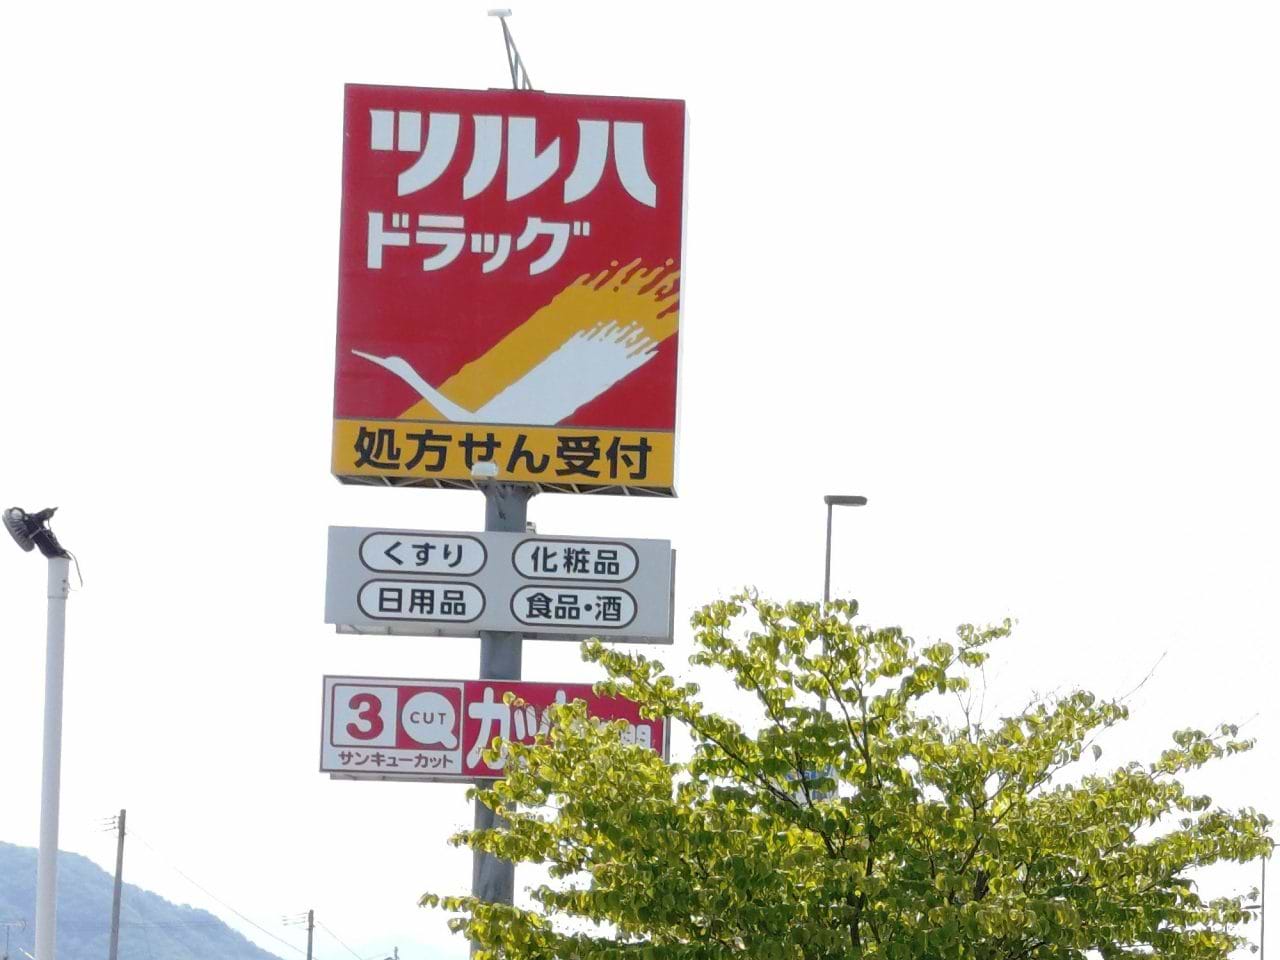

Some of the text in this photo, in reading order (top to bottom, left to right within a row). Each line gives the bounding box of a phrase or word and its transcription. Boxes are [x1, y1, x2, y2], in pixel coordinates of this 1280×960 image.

[368, 109, 657, 208] ツルハ
[367, 212, 590, 275] ドラッグ
[354, 426, 652, 479] 処方せん受付
[383, 541, 464, 568] くすり
[531, 546, 620, 576] 化粧品
[378, 587, 467, 616] 日用品
[409, 711, 446, 726] CUT
[338, 750, 454, 769] サンキューカット
